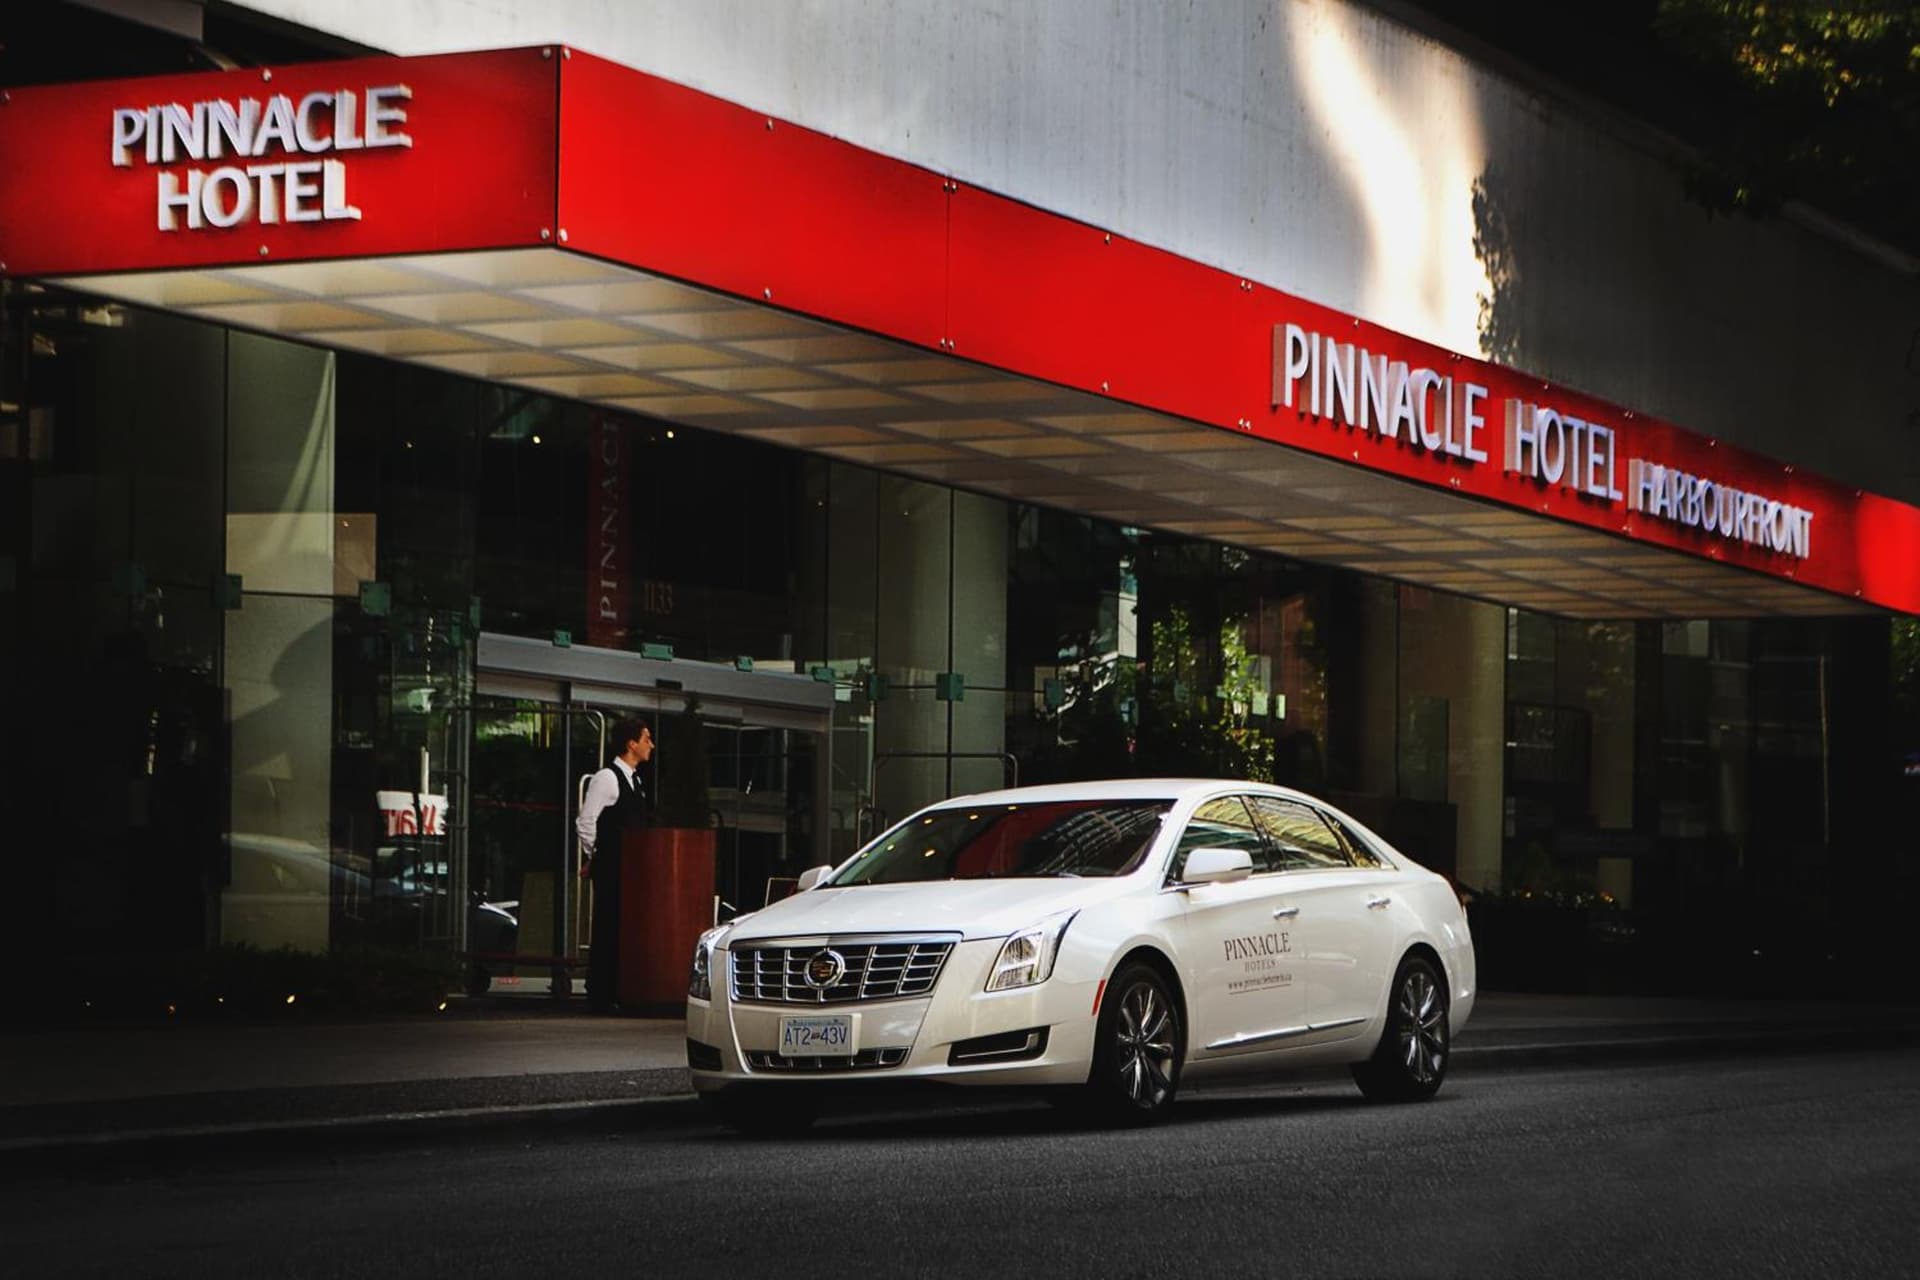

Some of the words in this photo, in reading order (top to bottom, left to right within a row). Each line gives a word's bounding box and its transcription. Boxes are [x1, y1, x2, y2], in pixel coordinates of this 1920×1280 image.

[112, 84, 412, 166] PINNACLE
[158, 159, 362, 231] HOTEL
[1273, 323, 1488, 464] PINNACLE
[1505, 399, 1623, 501] HOTEL
[1629, 459, 1813, 559] HARBOURFRONT
[1224, 932, 1291, 961] PINNACLE
[1244, 959, 1277, 973] HOTELS
